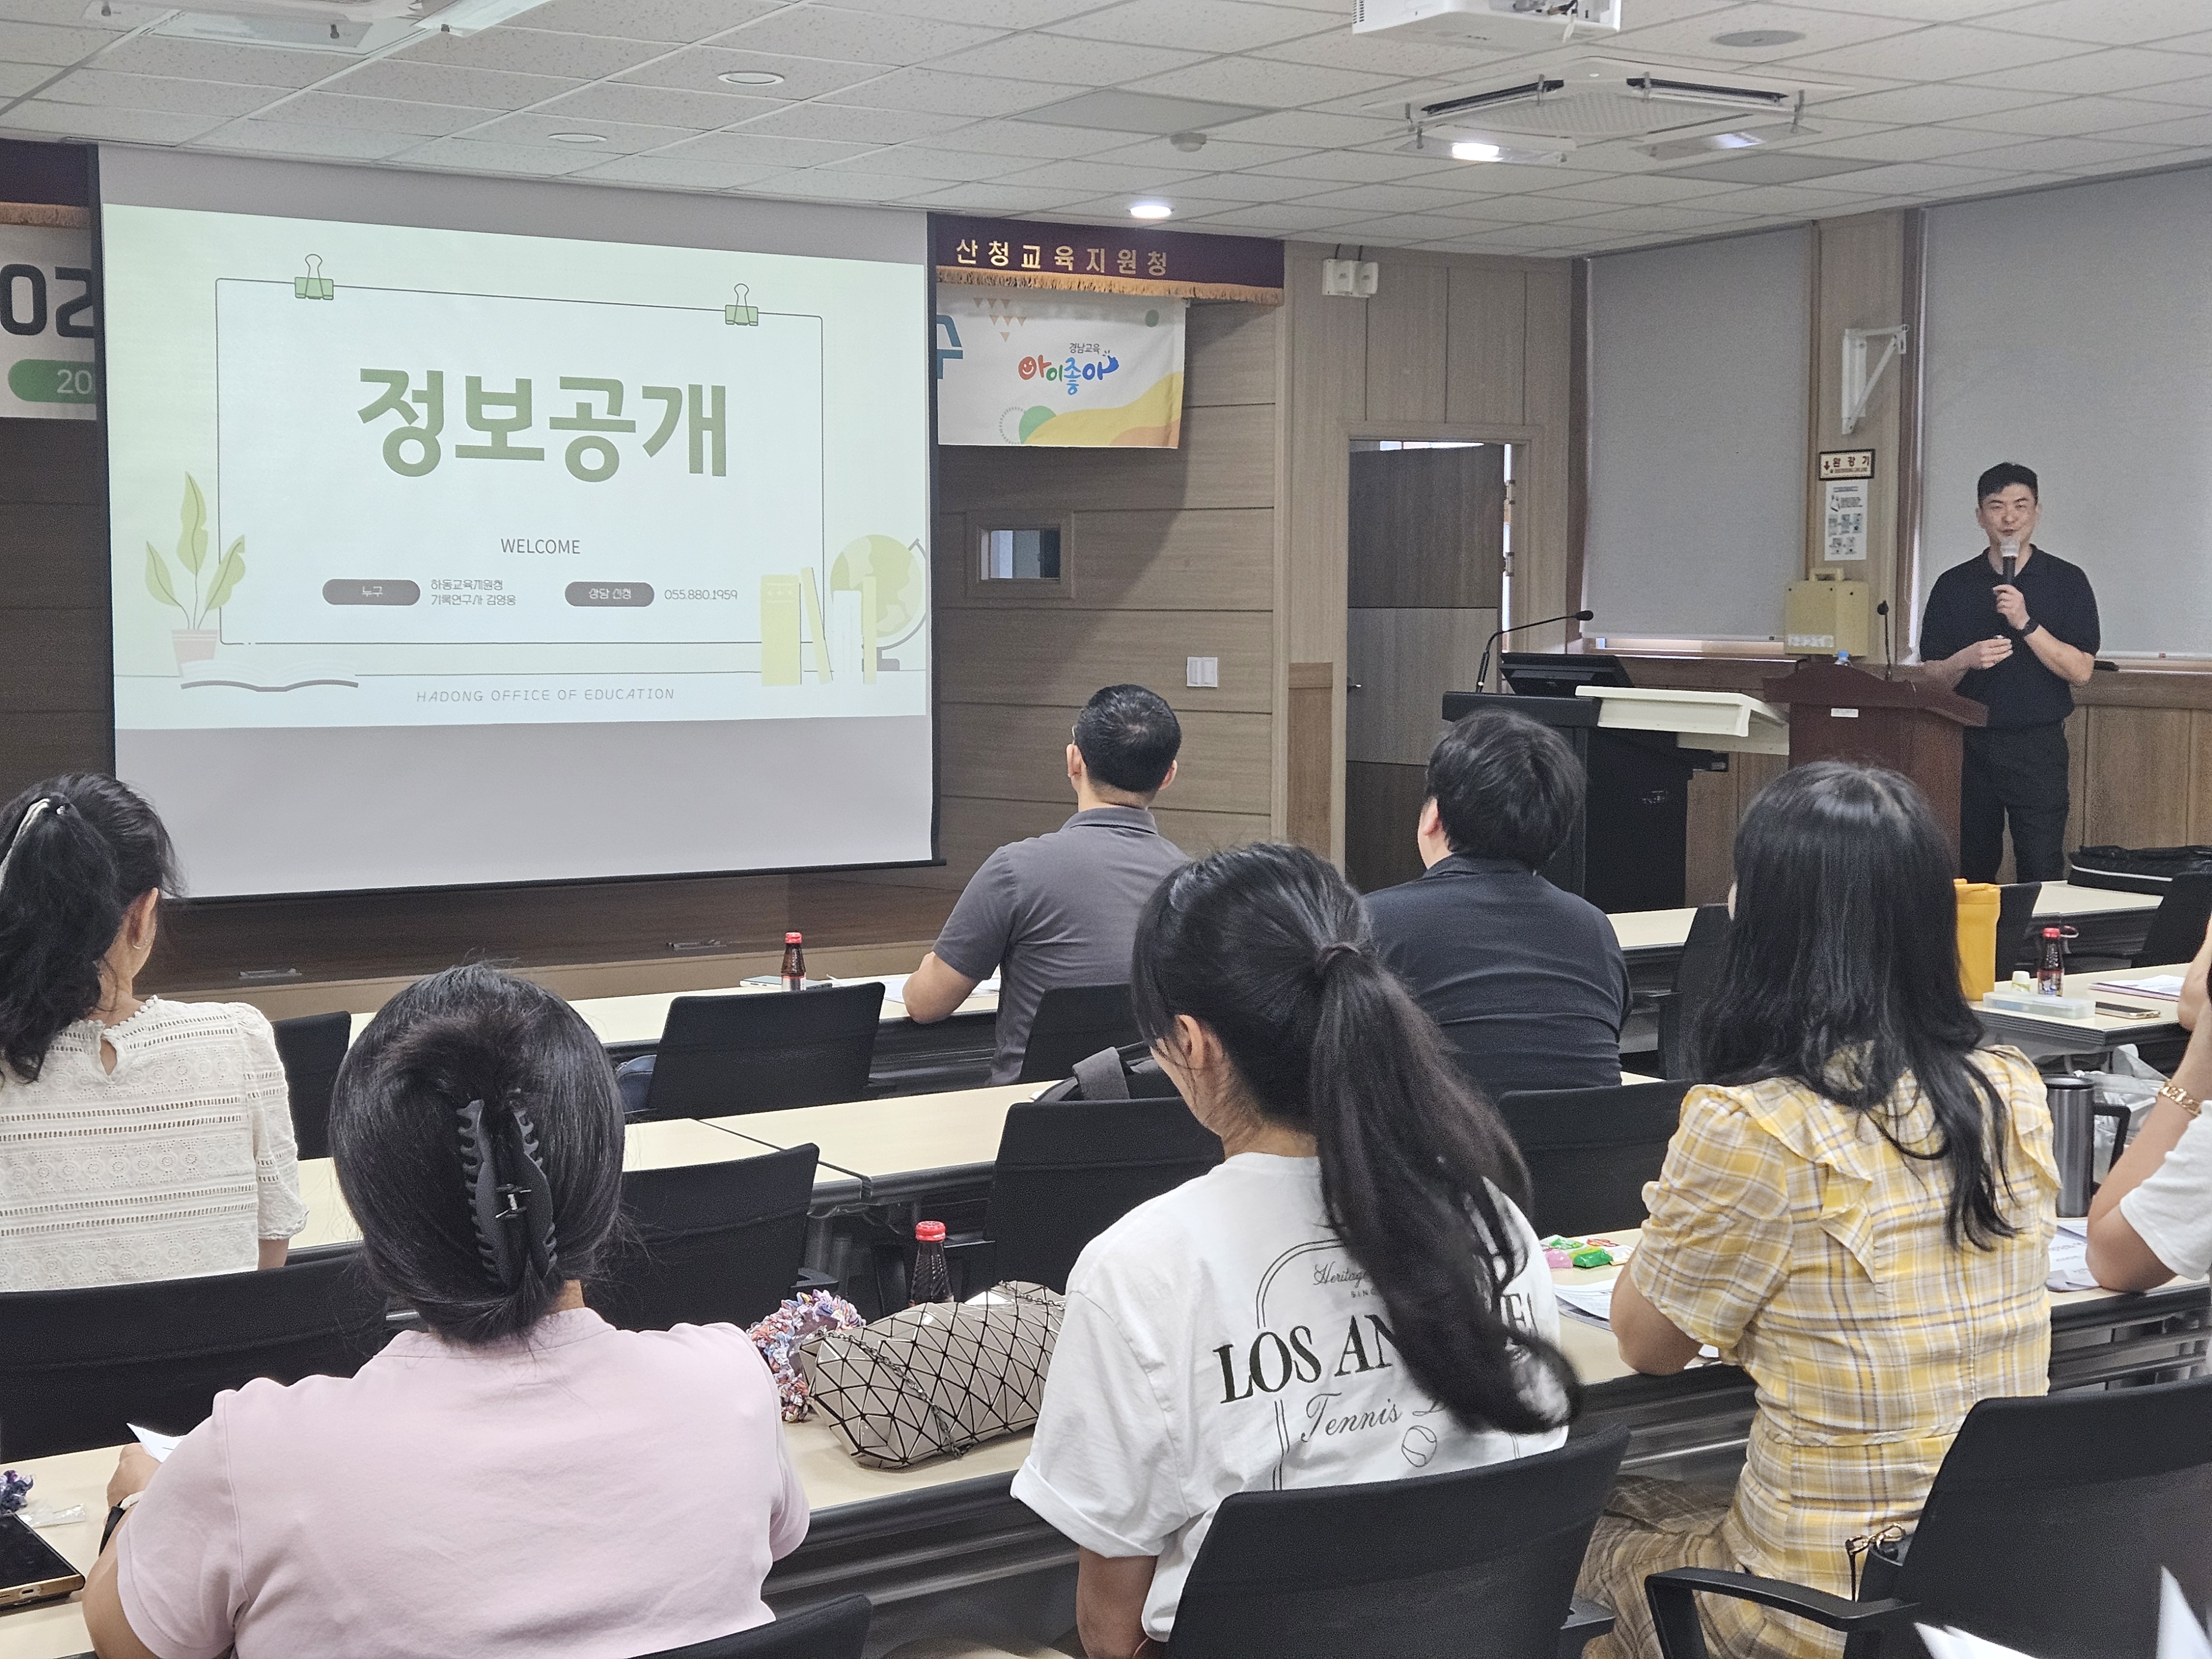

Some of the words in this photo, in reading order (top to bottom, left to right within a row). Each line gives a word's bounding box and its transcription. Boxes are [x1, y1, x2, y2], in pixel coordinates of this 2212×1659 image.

[956, 239, 1167, 276] 산청교육지원청
[1069, 342, 1100, 354] 경남교육
[1018, 354, 1119, 395] 아이좋아
[357, 368, 727, 483] 정보공개
[500, 538, 581, 554] WELCOME
[362, 586, 383, 597] 누구
[430, 579, 503, 591] 하동교육지원청
[588, 588, 610, 599] 상담
[664, 589, 738, 600] 055.880.1959
[416, 690, 484, 702] HADONG
[491, 690, 551, 701] OFFICE
[558, 689, 577, 701] OF
[584, 688, 675, 701] EDUCATION
[1313, 1260, 1367, 1288] Heritag
[1213, 1325, 1322, 1405] LOS
[1300, 1392, 1404, 1443] Tennis
